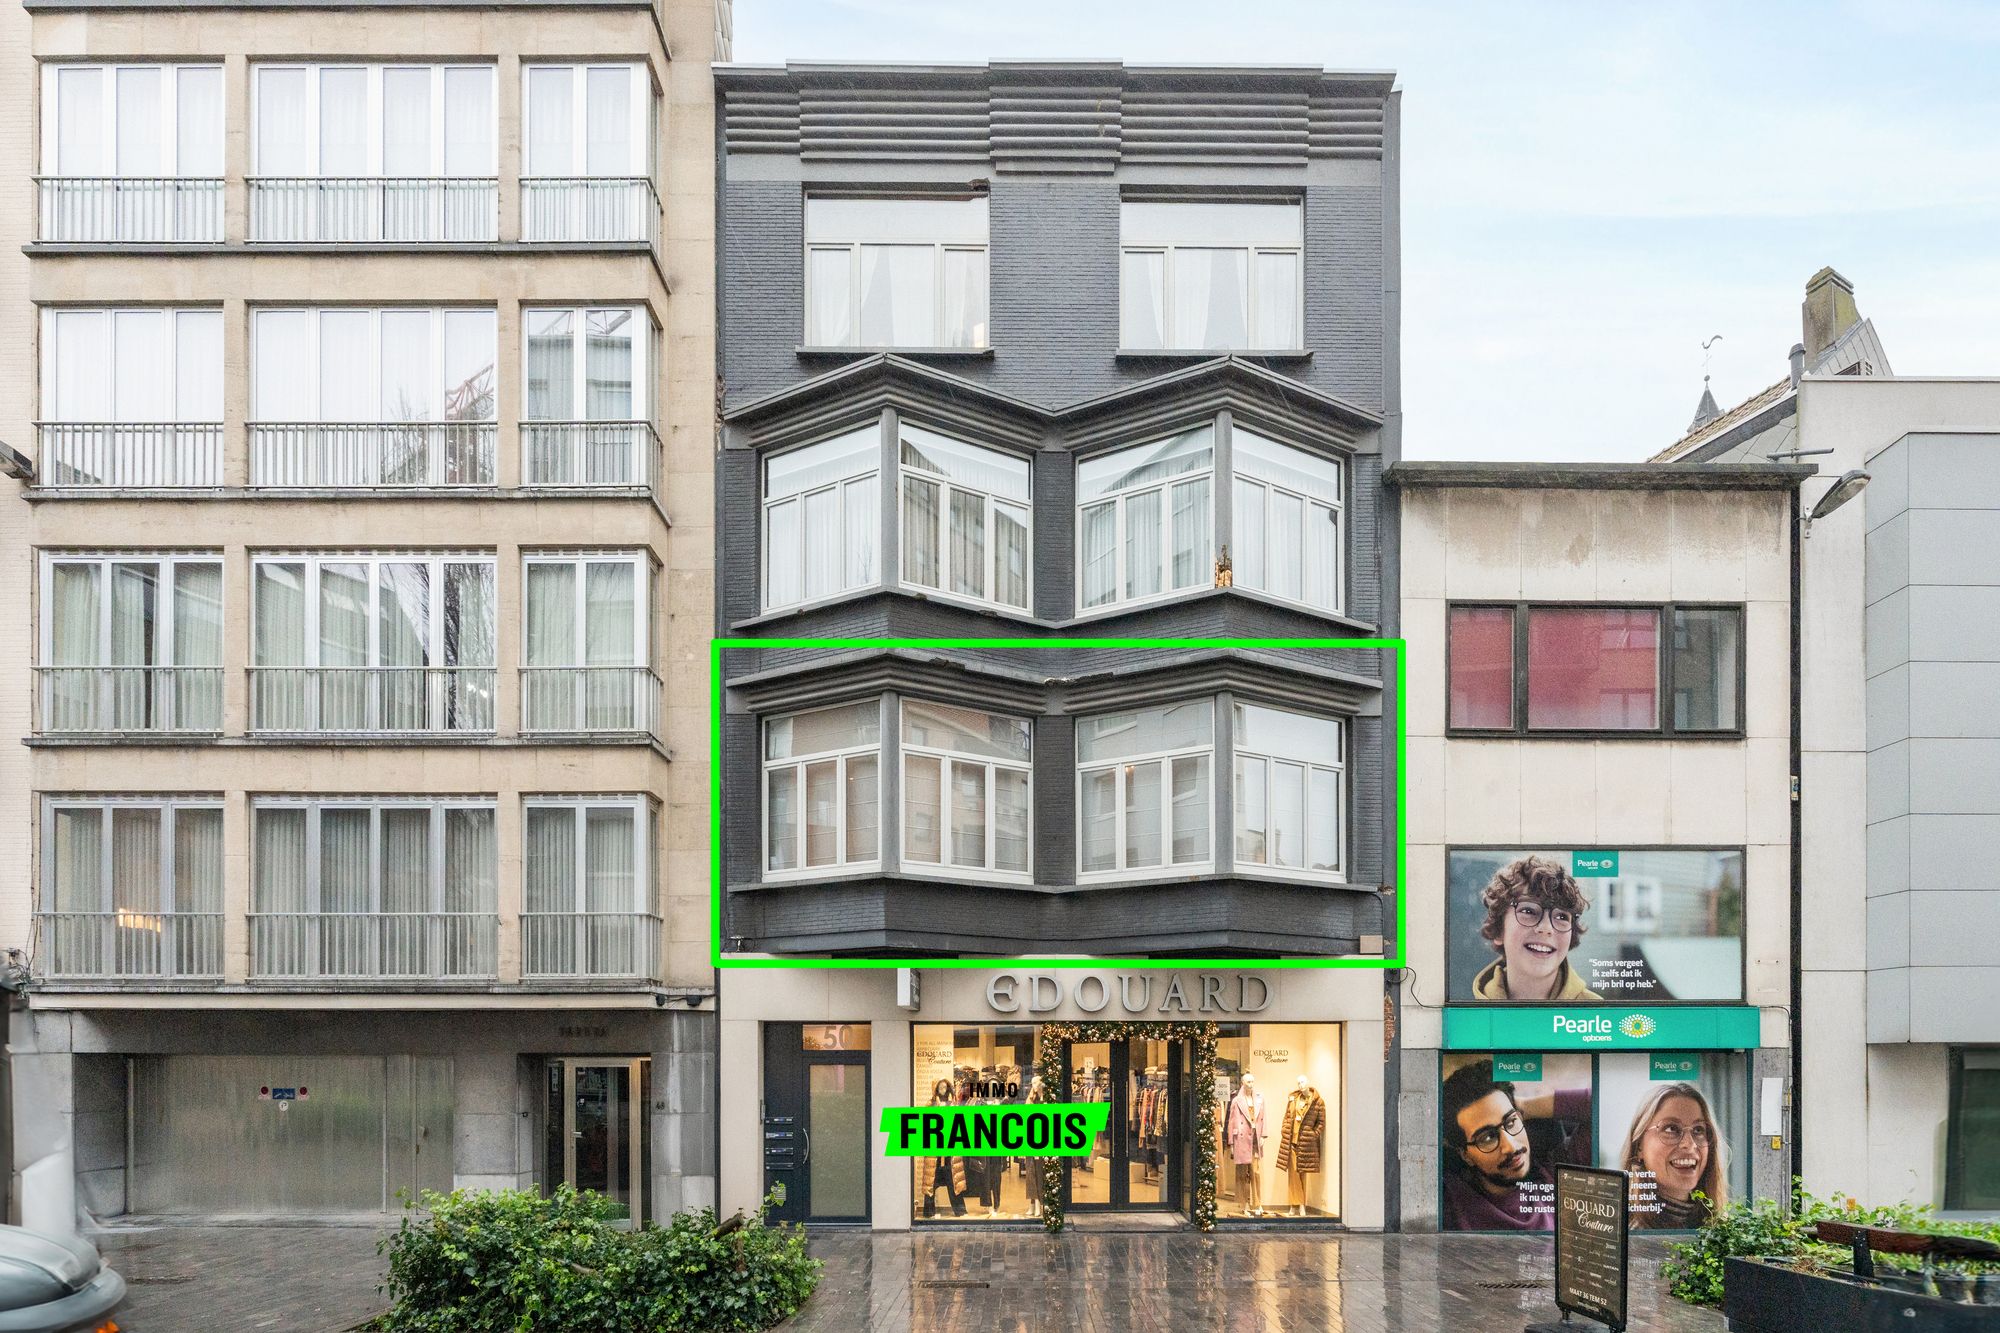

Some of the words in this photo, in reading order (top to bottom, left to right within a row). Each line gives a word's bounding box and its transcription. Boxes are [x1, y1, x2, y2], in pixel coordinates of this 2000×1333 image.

[1577, 859, 1599, 867] Pearle
[1614, 959, 1643, 969] vergeet
[1592, 969, 1600, 977] ik
[1601, 969, 1619, 977] zelfs
[1620, 969, 1633, 977] dat
[1634, 969, 1642, 977] ik
[1592, 980, 1610, 990] mijn
[1611, 980, 1624, 988] bril
[1625, 981, 1636, 990] op
[986, 974, 1275, 1012] EDOUARD
[1553, 1015, 1612, 1033] Pearle
[823, 1025, 853, 1050] 50
[1253, 1049, 1289, 1057] EDOUARD
[1498, 1062, 1521, 1070] Pearle
[1654, 1061, 1677, 1069] Pearle
[1539, 1184, 1554, 1192] oge
[1519, 1193, 1528, 1201] ik
[1639, 1192, 1657, 1201] stuk
[1519, 1205, 1533, 1213] toe
[1534, 1205, 1555, 1213] ruste
[1564, 1197, 1615, 1218] EDOUARD
[1576, 1208, 1614, 1233] Couture
